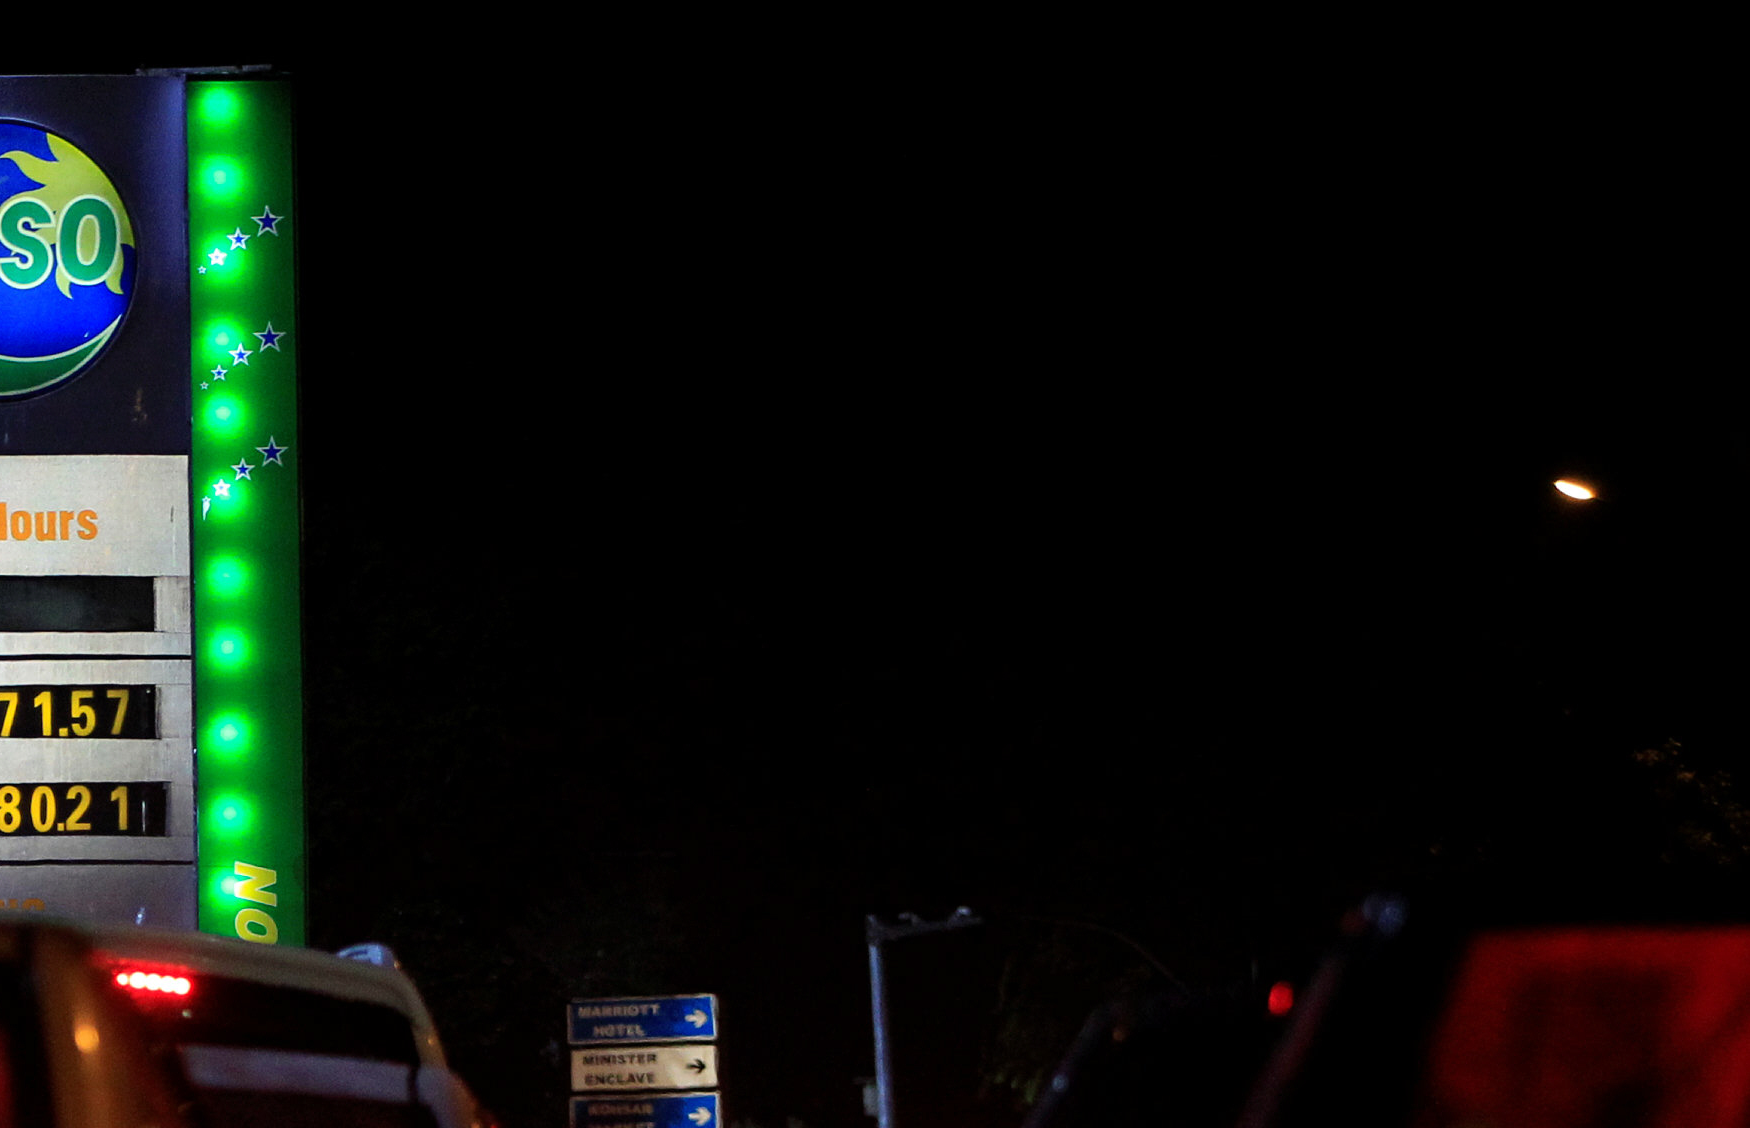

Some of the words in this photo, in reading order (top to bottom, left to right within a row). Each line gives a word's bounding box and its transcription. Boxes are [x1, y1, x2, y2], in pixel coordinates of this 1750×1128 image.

[577, 1003, 661, 1018] MARRIOTT
[591, 1023, 646, 1038] HOTEL
[582, 1053, 657, 1066] MINISTER
[583, 1072, 654, 1086] ENCLAVE
